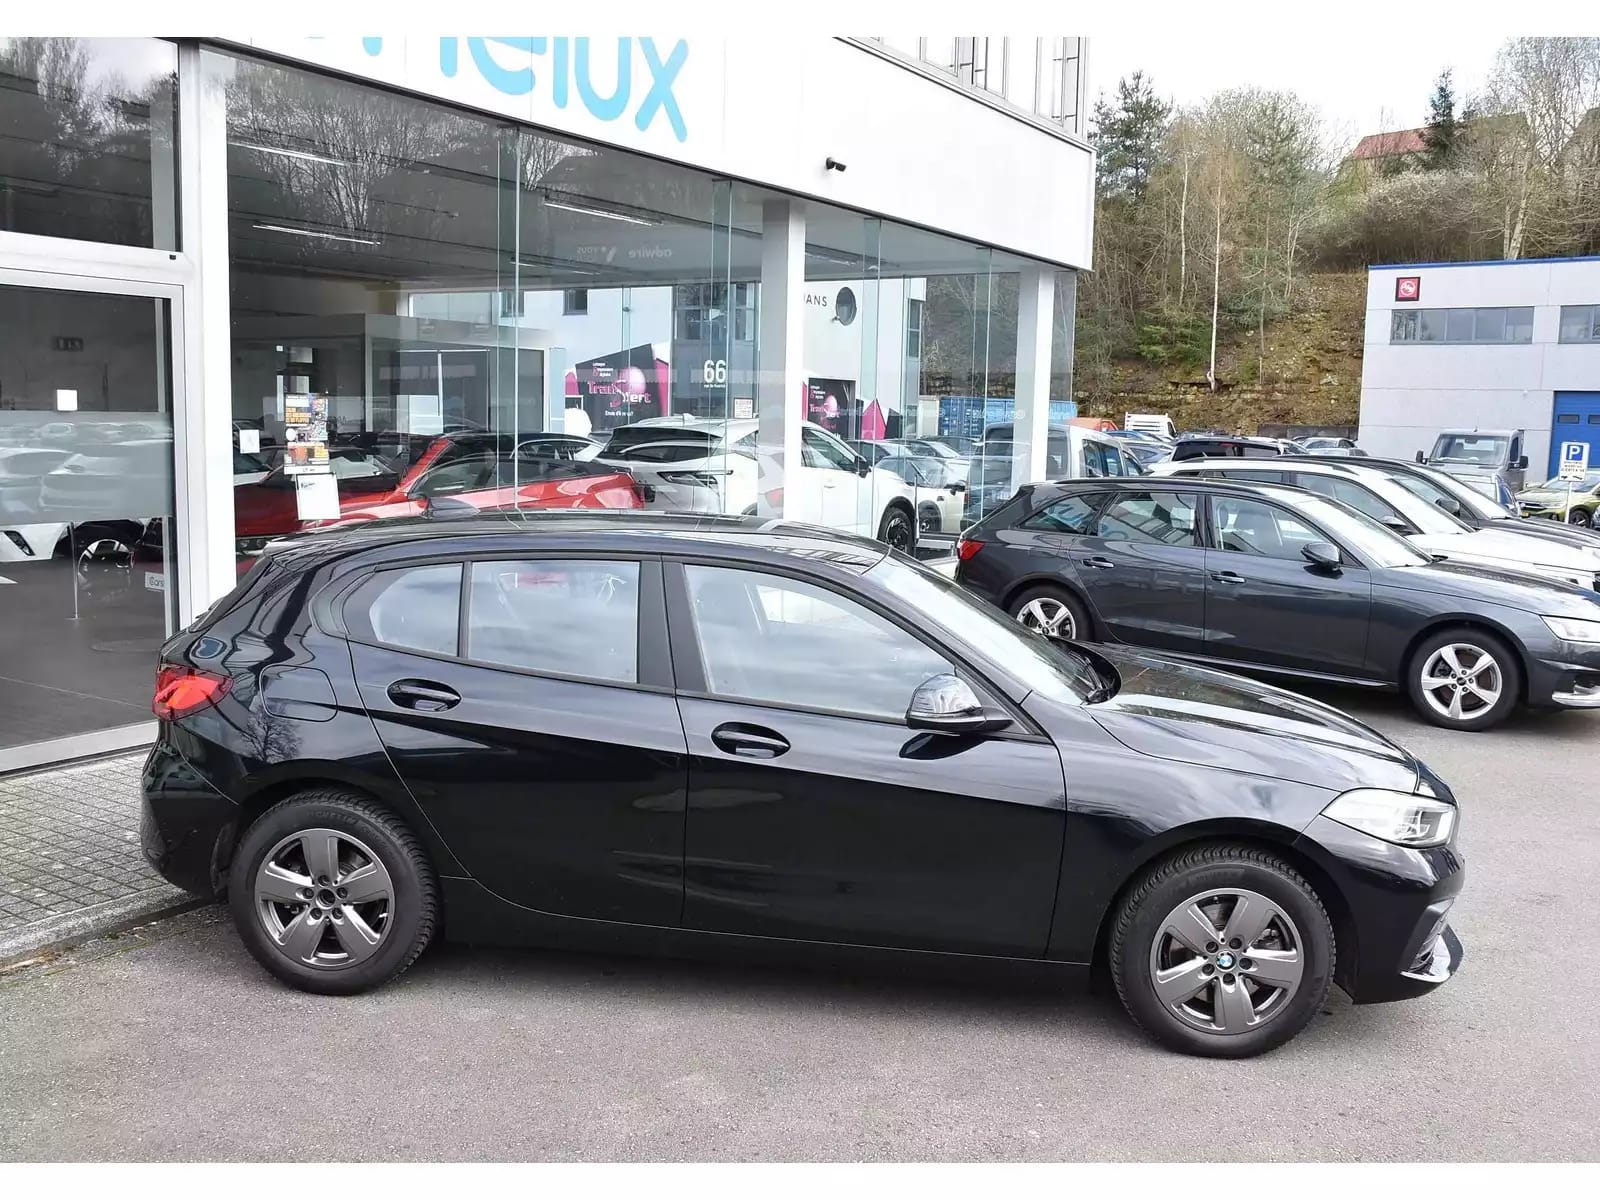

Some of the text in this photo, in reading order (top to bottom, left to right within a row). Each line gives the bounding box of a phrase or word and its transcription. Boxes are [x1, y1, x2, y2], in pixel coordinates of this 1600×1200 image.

[363, 37, 689, 143] elux
[804, 293, 828, 307] ANS
[703, 359, 726, 383] 66
[1568, 446, 1581, 460] P
